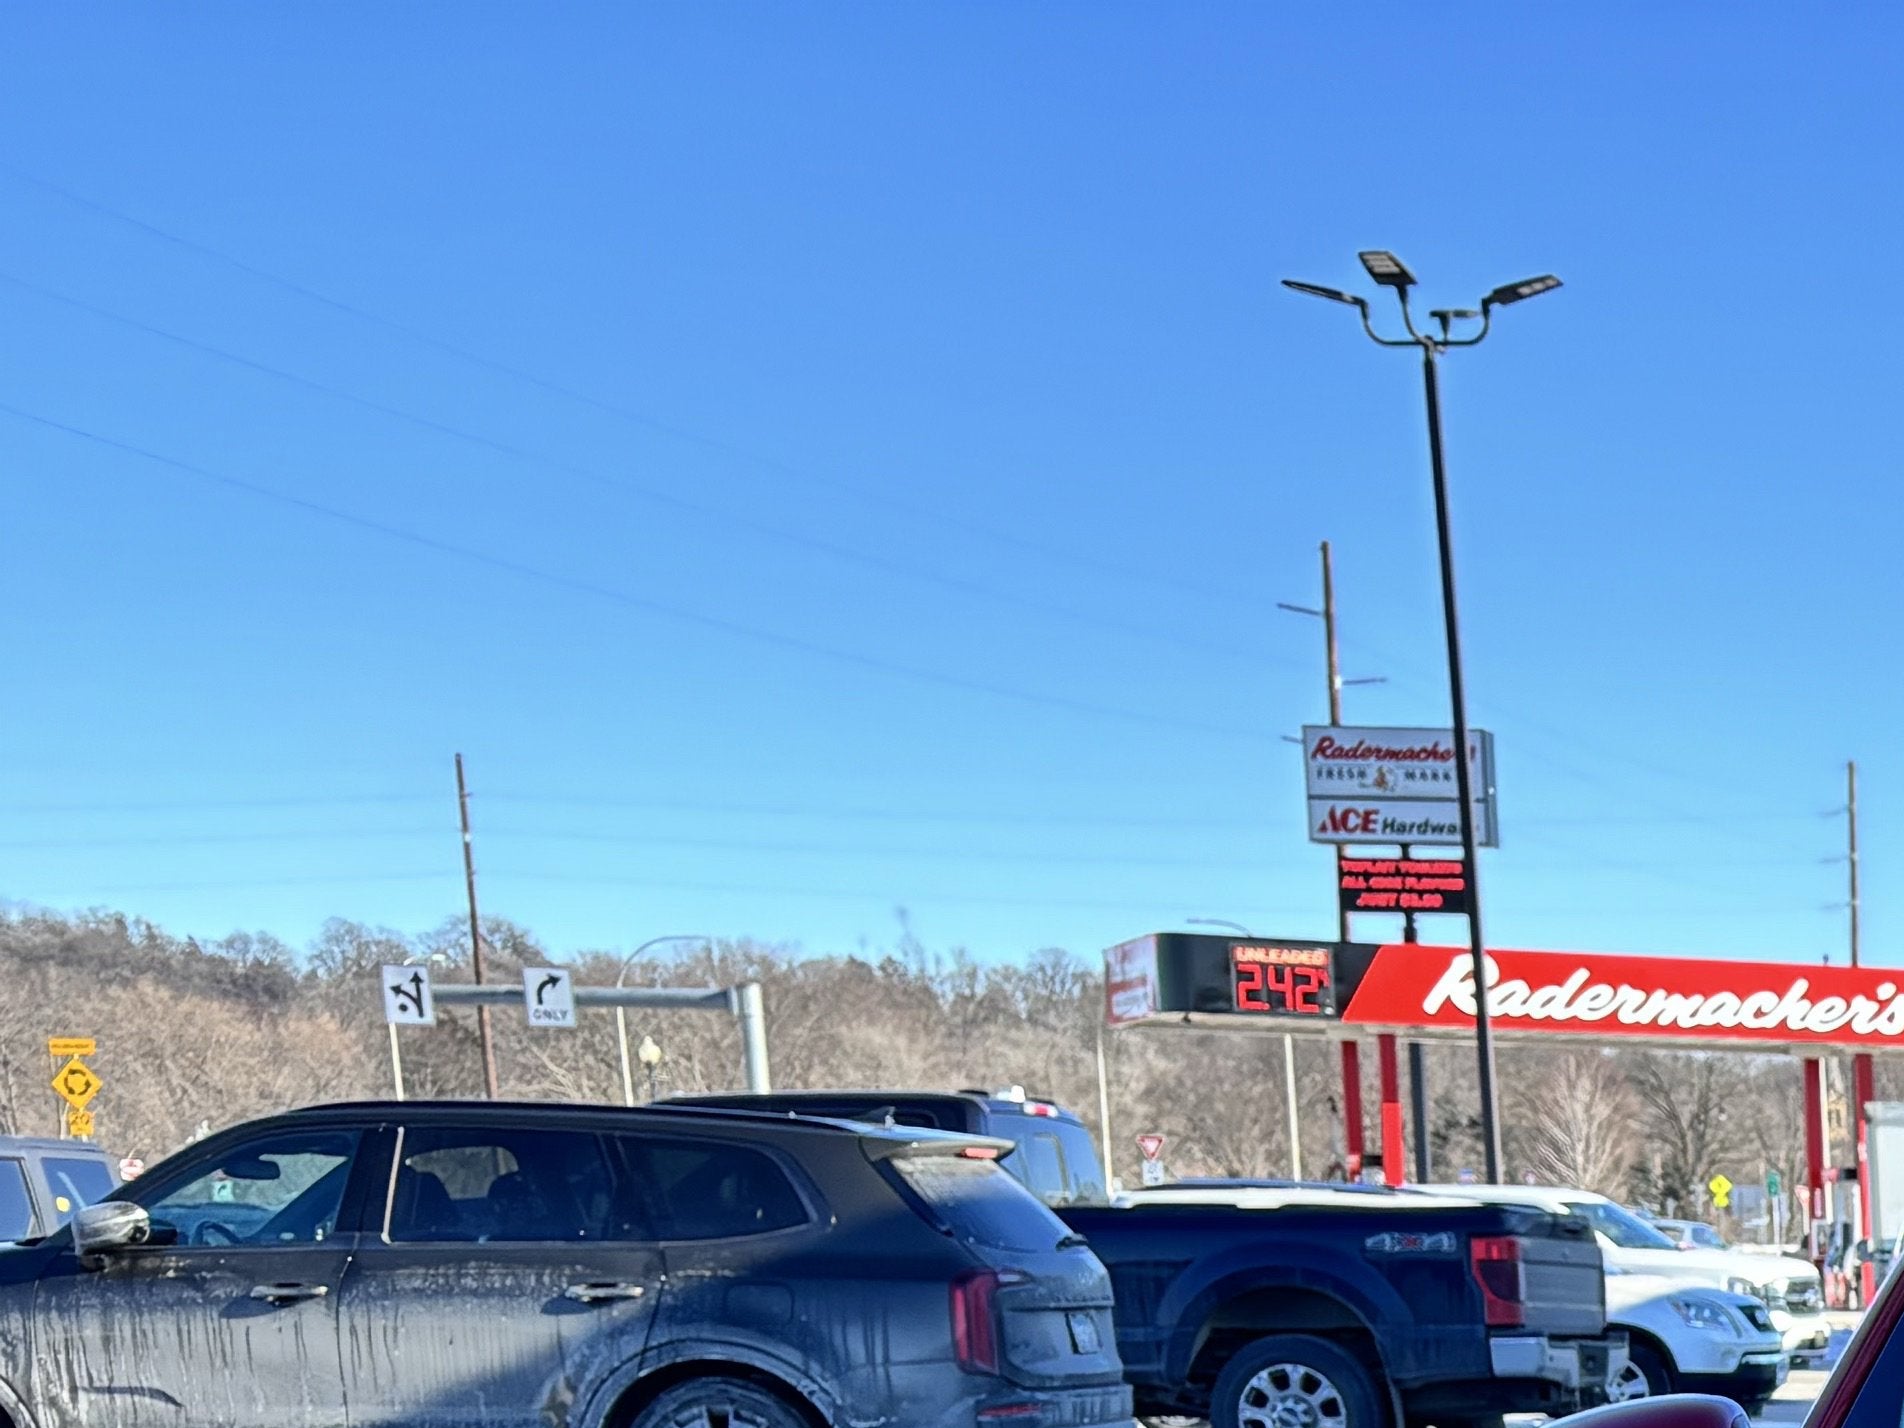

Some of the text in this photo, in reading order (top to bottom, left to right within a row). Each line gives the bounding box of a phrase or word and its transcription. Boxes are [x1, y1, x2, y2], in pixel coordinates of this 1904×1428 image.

[1318, 806, 1458, 835] ACE Hardwa
[1233, 946, 1326, 965] UNLEADED
[532, 1008, 569, 1021] ONLY
